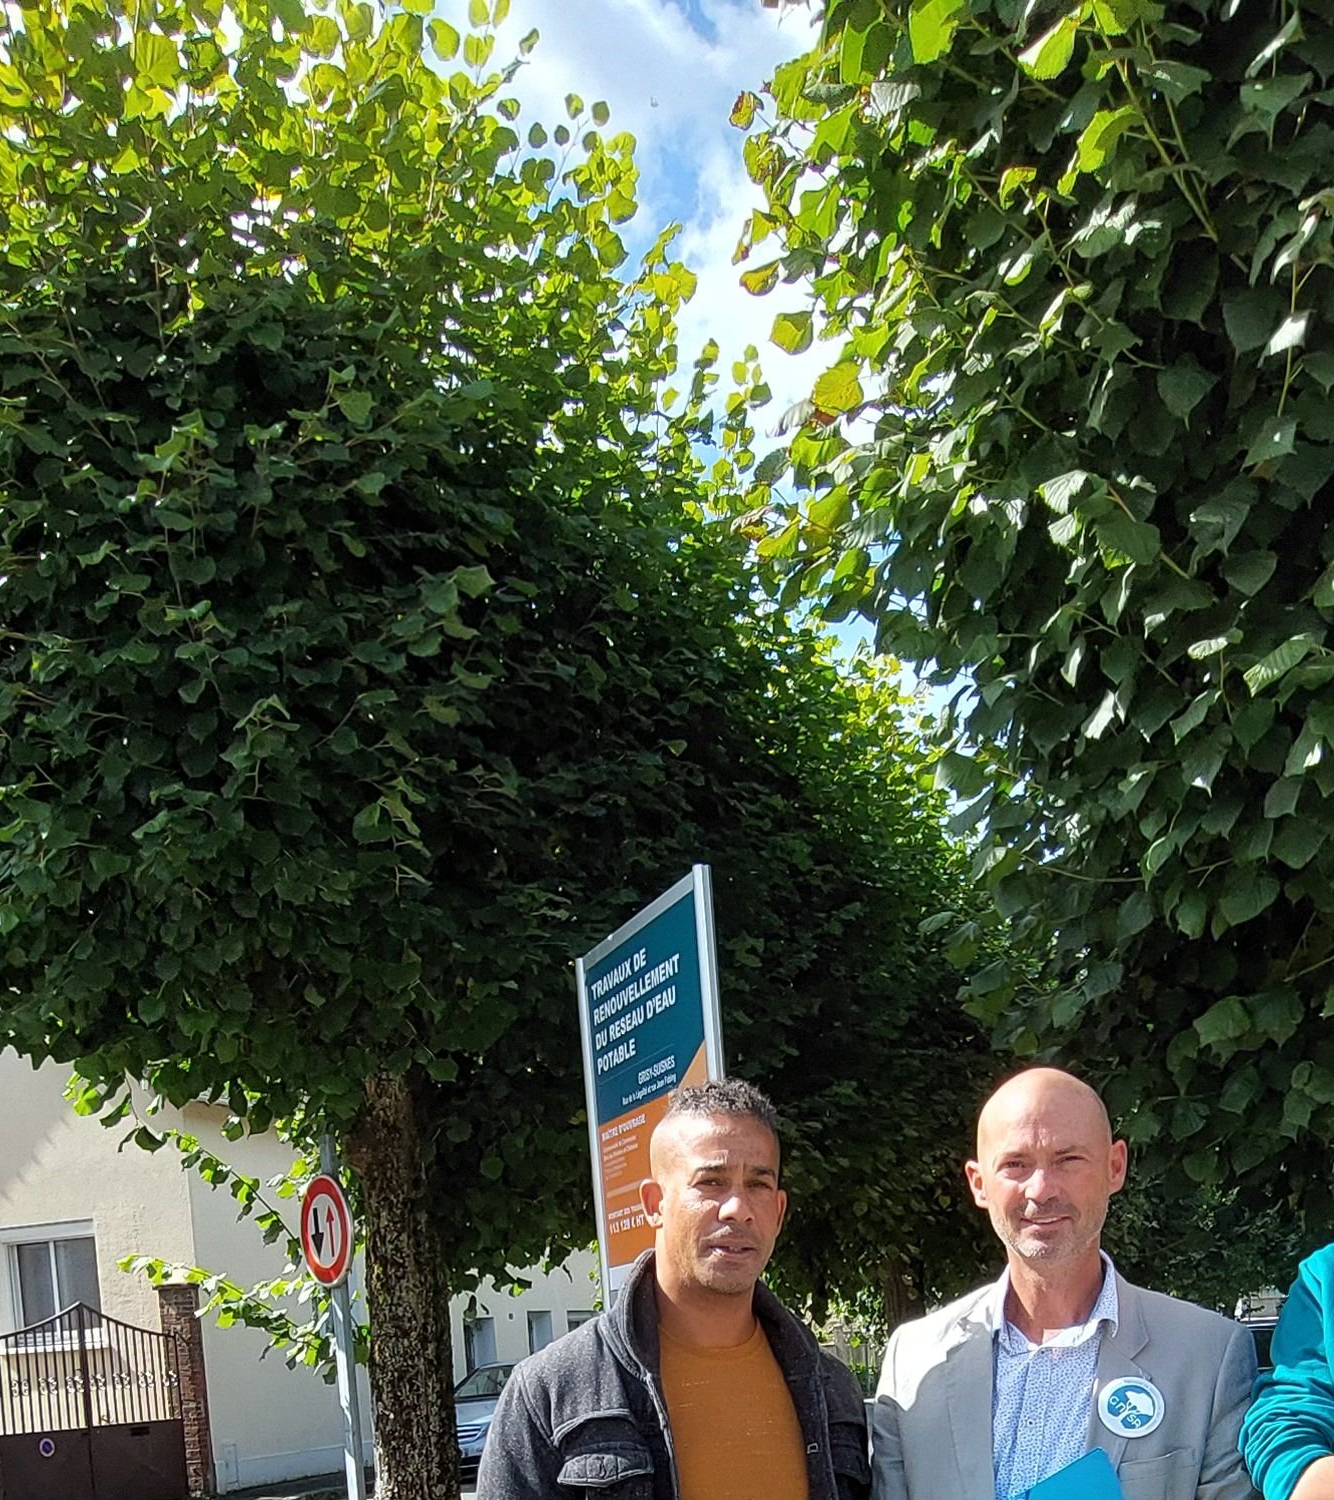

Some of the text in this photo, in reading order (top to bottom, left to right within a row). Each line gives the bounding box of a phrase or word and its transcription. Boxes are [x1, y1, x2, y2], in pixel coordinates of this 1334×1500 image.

[591, 947, 646, 1000] TRAVAUX DE
[593, 953, 679, 1026] RENOUVELLEMENT
[595, 985, 676, 1050] DU RESEAU D'EAU
[597, 1038, 636, 1075] POTABLE
[637, 1055, 675, 1084] GRISY-SUISNES
